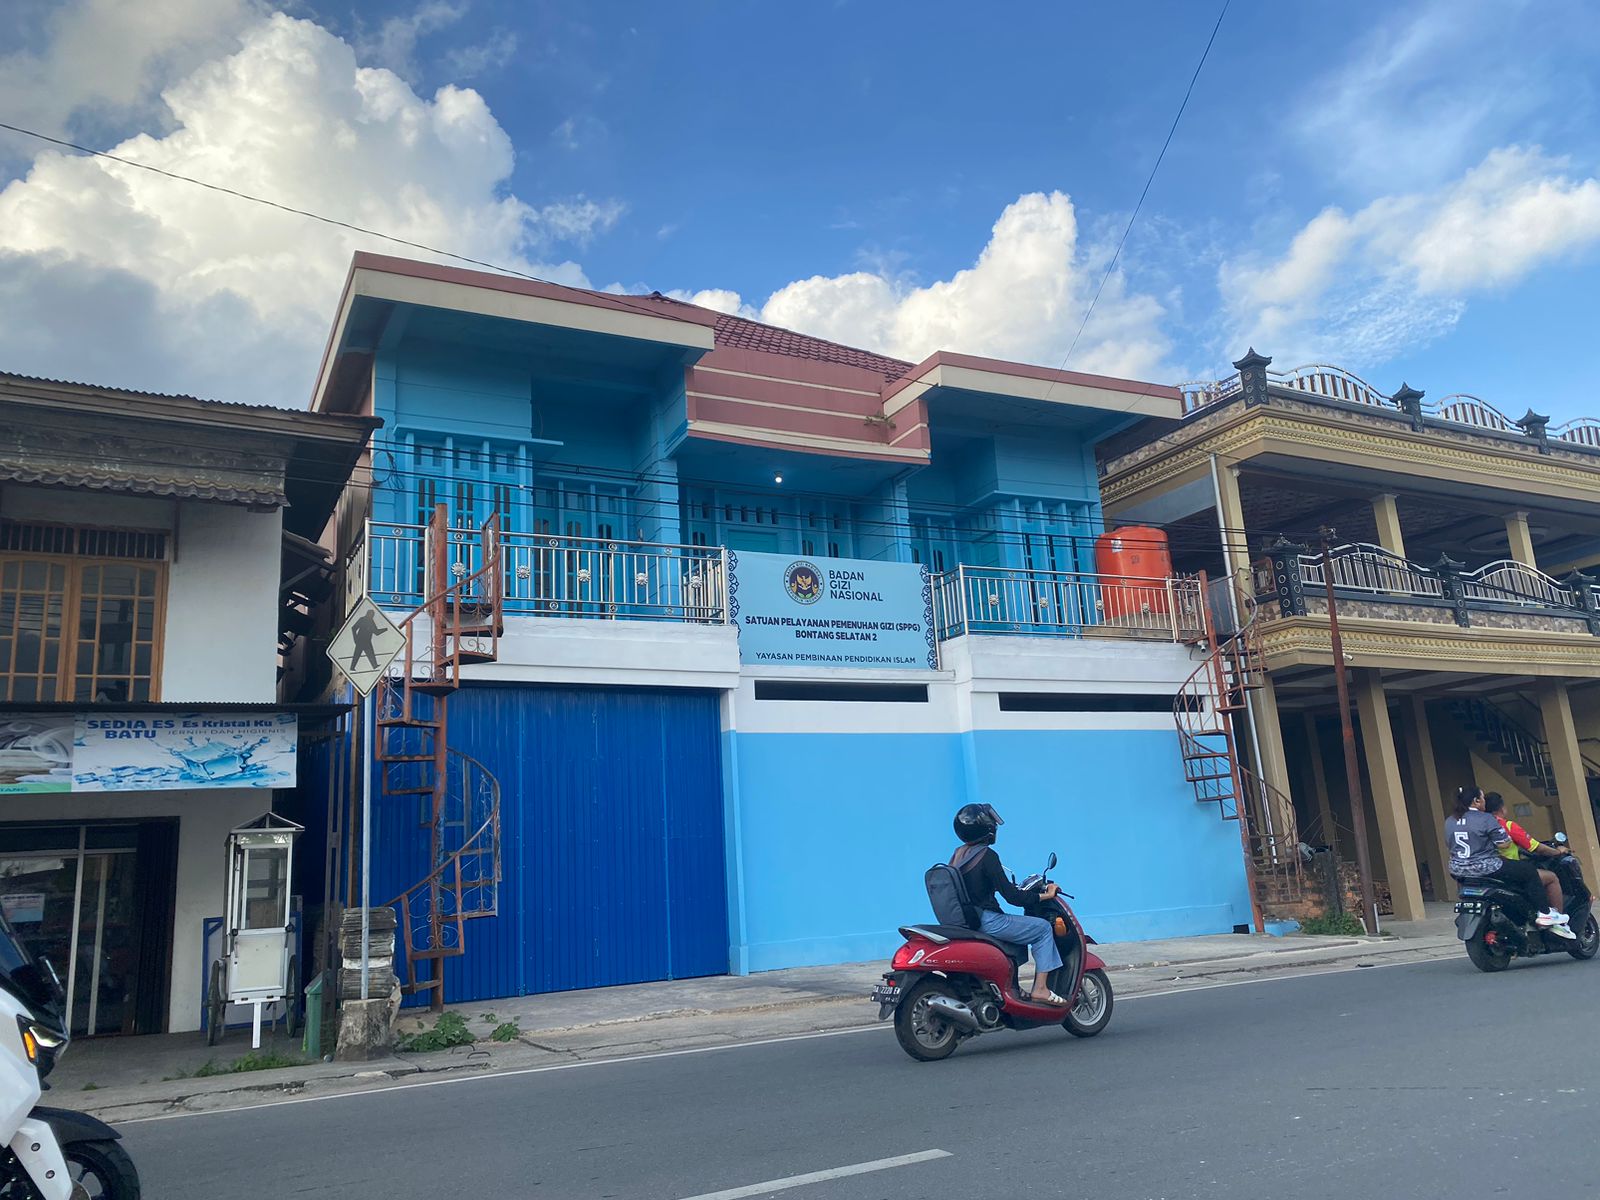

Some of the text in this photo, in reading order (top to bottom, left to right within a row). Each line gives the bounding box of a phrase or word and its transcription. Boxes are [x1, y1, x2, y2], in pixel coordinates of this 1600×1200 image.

[829, 570, 864, 580] BADAN
[830, 580, 850, 590] GIZI
[830, 590, 884, 601] NASIONAL
[745, 616, 780, 626] SATUAN
[781, 618, 830, 628] PELAYANAN
[831, 620, 878, 630] PEMENUHAN
[896, 622, 920, 632] (SPPG)
[796, 630, 834, 639] BONTANG
[836, 632, 871, 640] SELATAN
[756, 652, 793, 660] YAYASAN
[796, 654, 842, 662] PEMBINAAN
[88, 720, 175, 729] SEDIA ES
[105, 730, 156, 739] BATU
[1454, 832, 1470, 858] 5
